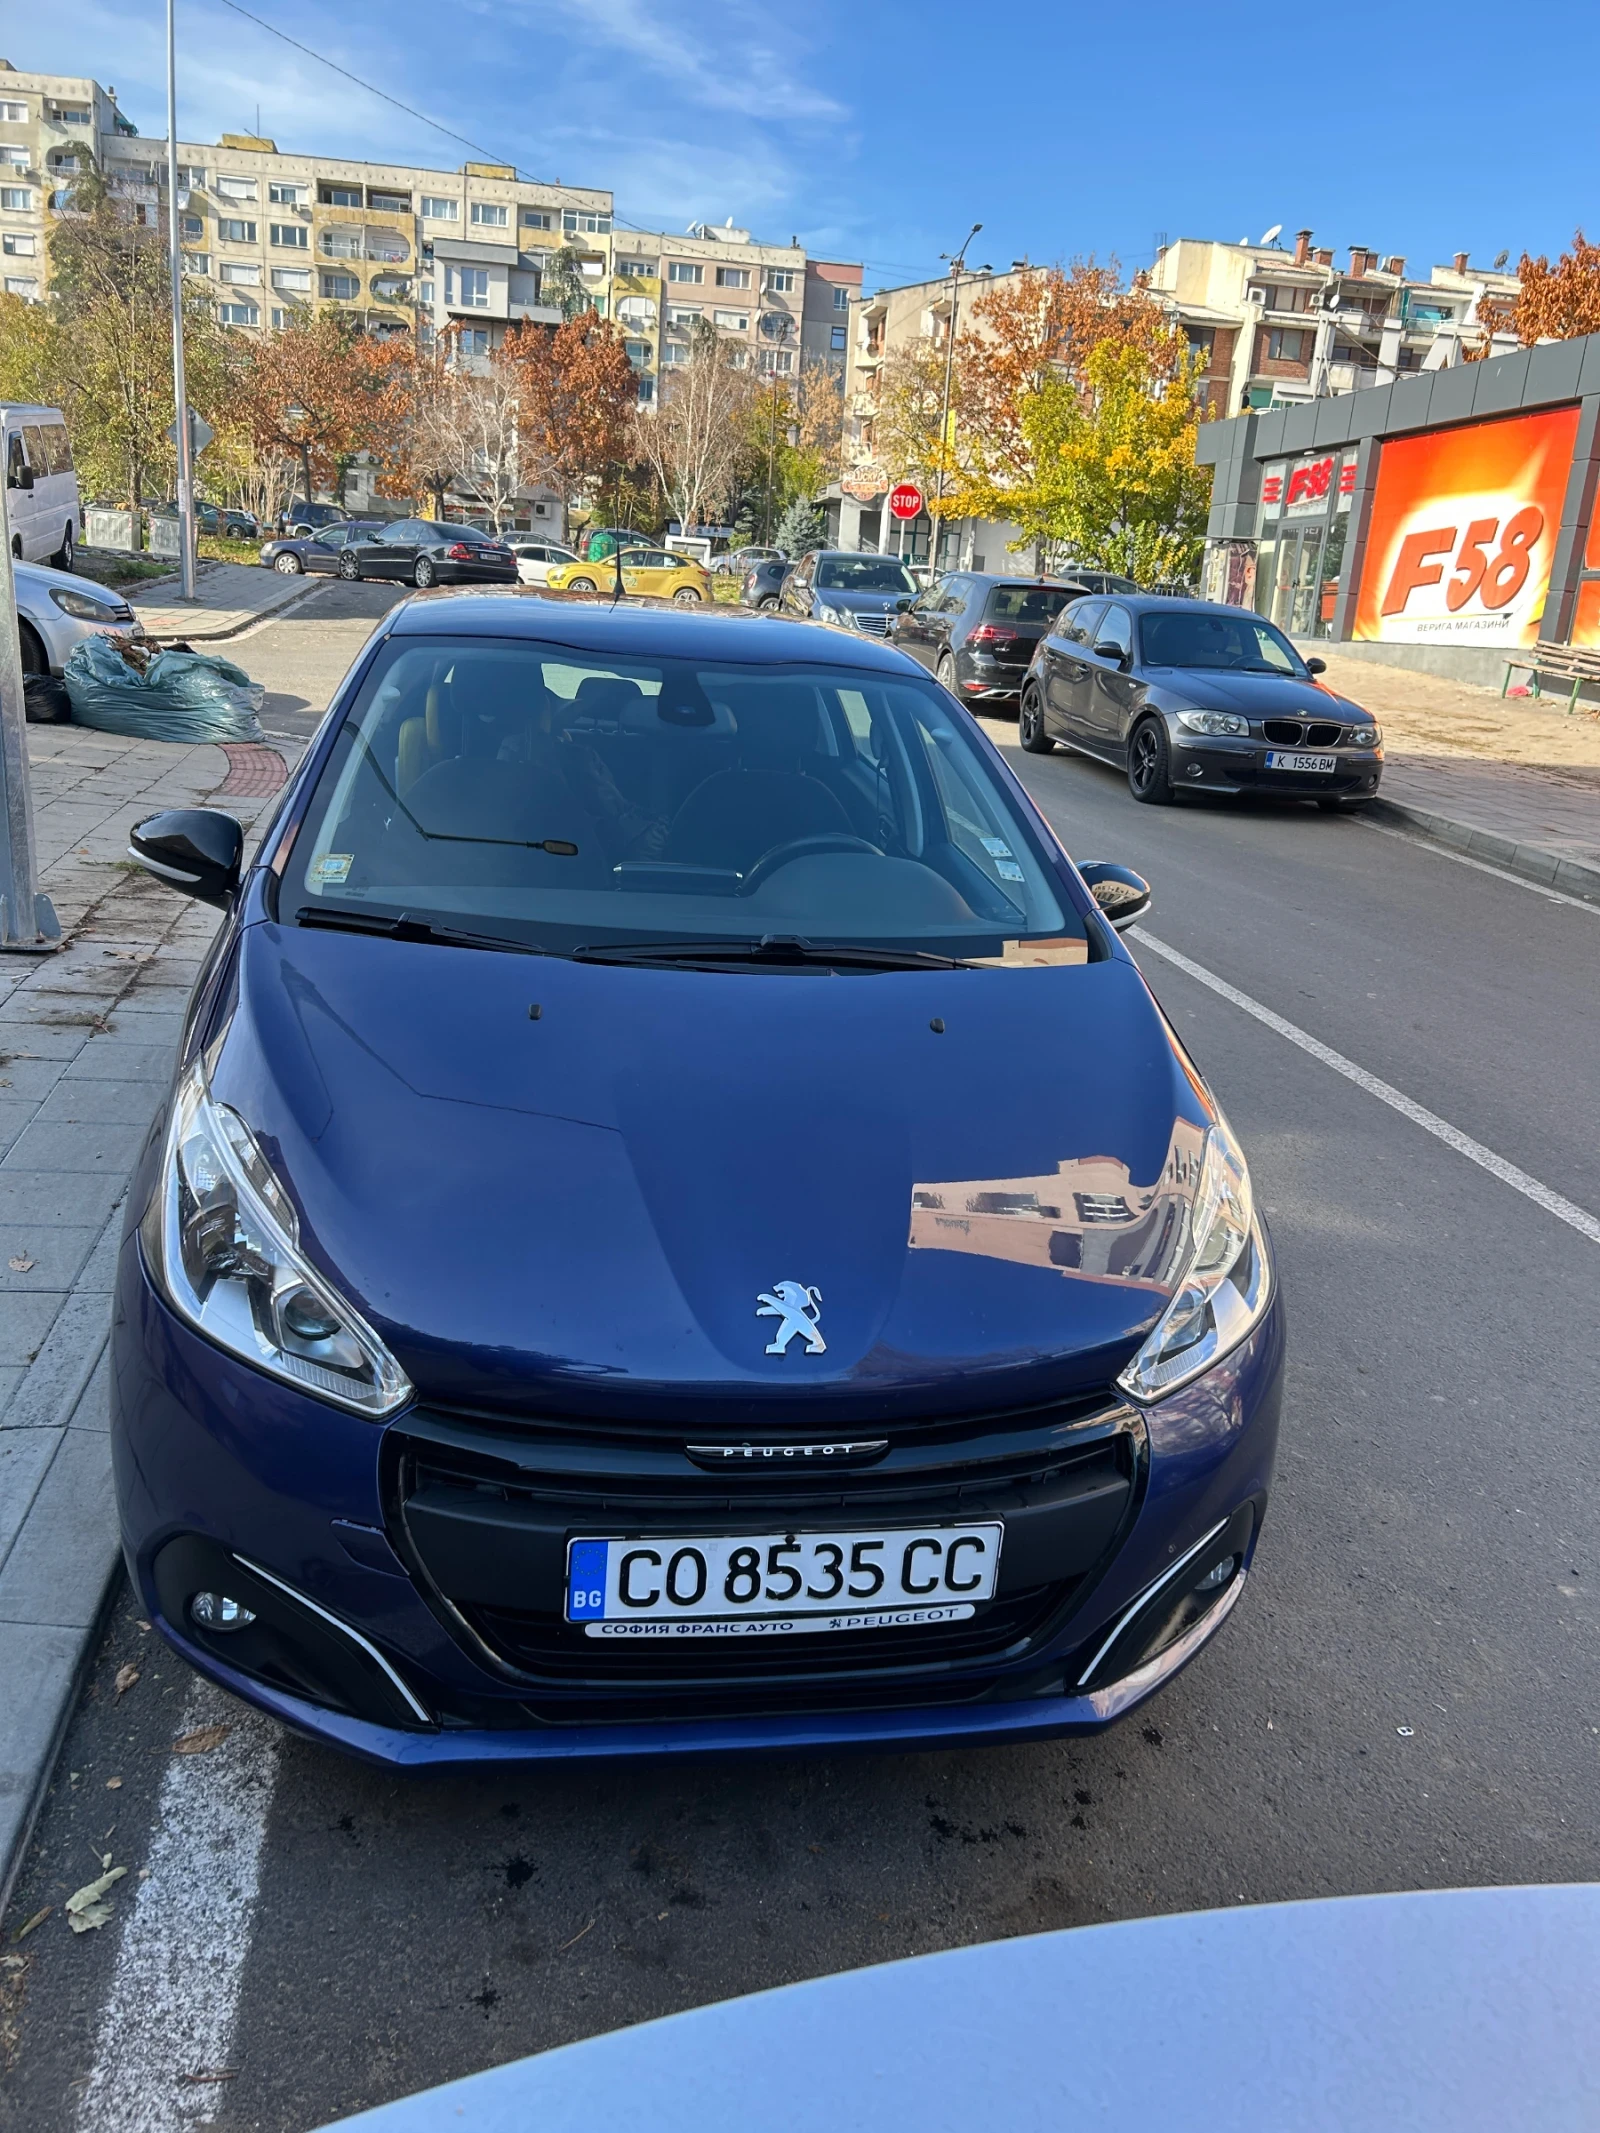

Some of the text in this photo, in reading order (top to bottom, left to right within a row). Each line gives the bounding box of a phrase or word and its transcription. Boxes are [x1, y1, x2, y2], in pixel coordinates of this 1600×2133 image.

[1285, 457, 1334, 504] F58
[892, 494, 919, 508] STOP
[1381, 506, 1544, 617] F58
[609, 577, 637, 587] 672
[1417, 620, 1510, 632] ВЕРИГА МАГАЗИНИ
[1293, 757, 1318, 769] 1556
[723, 1444, 853, 1457] PEUGEOT
[573, 1590, 602, 1609] BG
[724, 1540, 885, 1604] 8535
[847, 1608, 959, 1628] PEUGEOT
[601, 1622, 794, 1635] СОФИЯ ФРАНС АУТО
